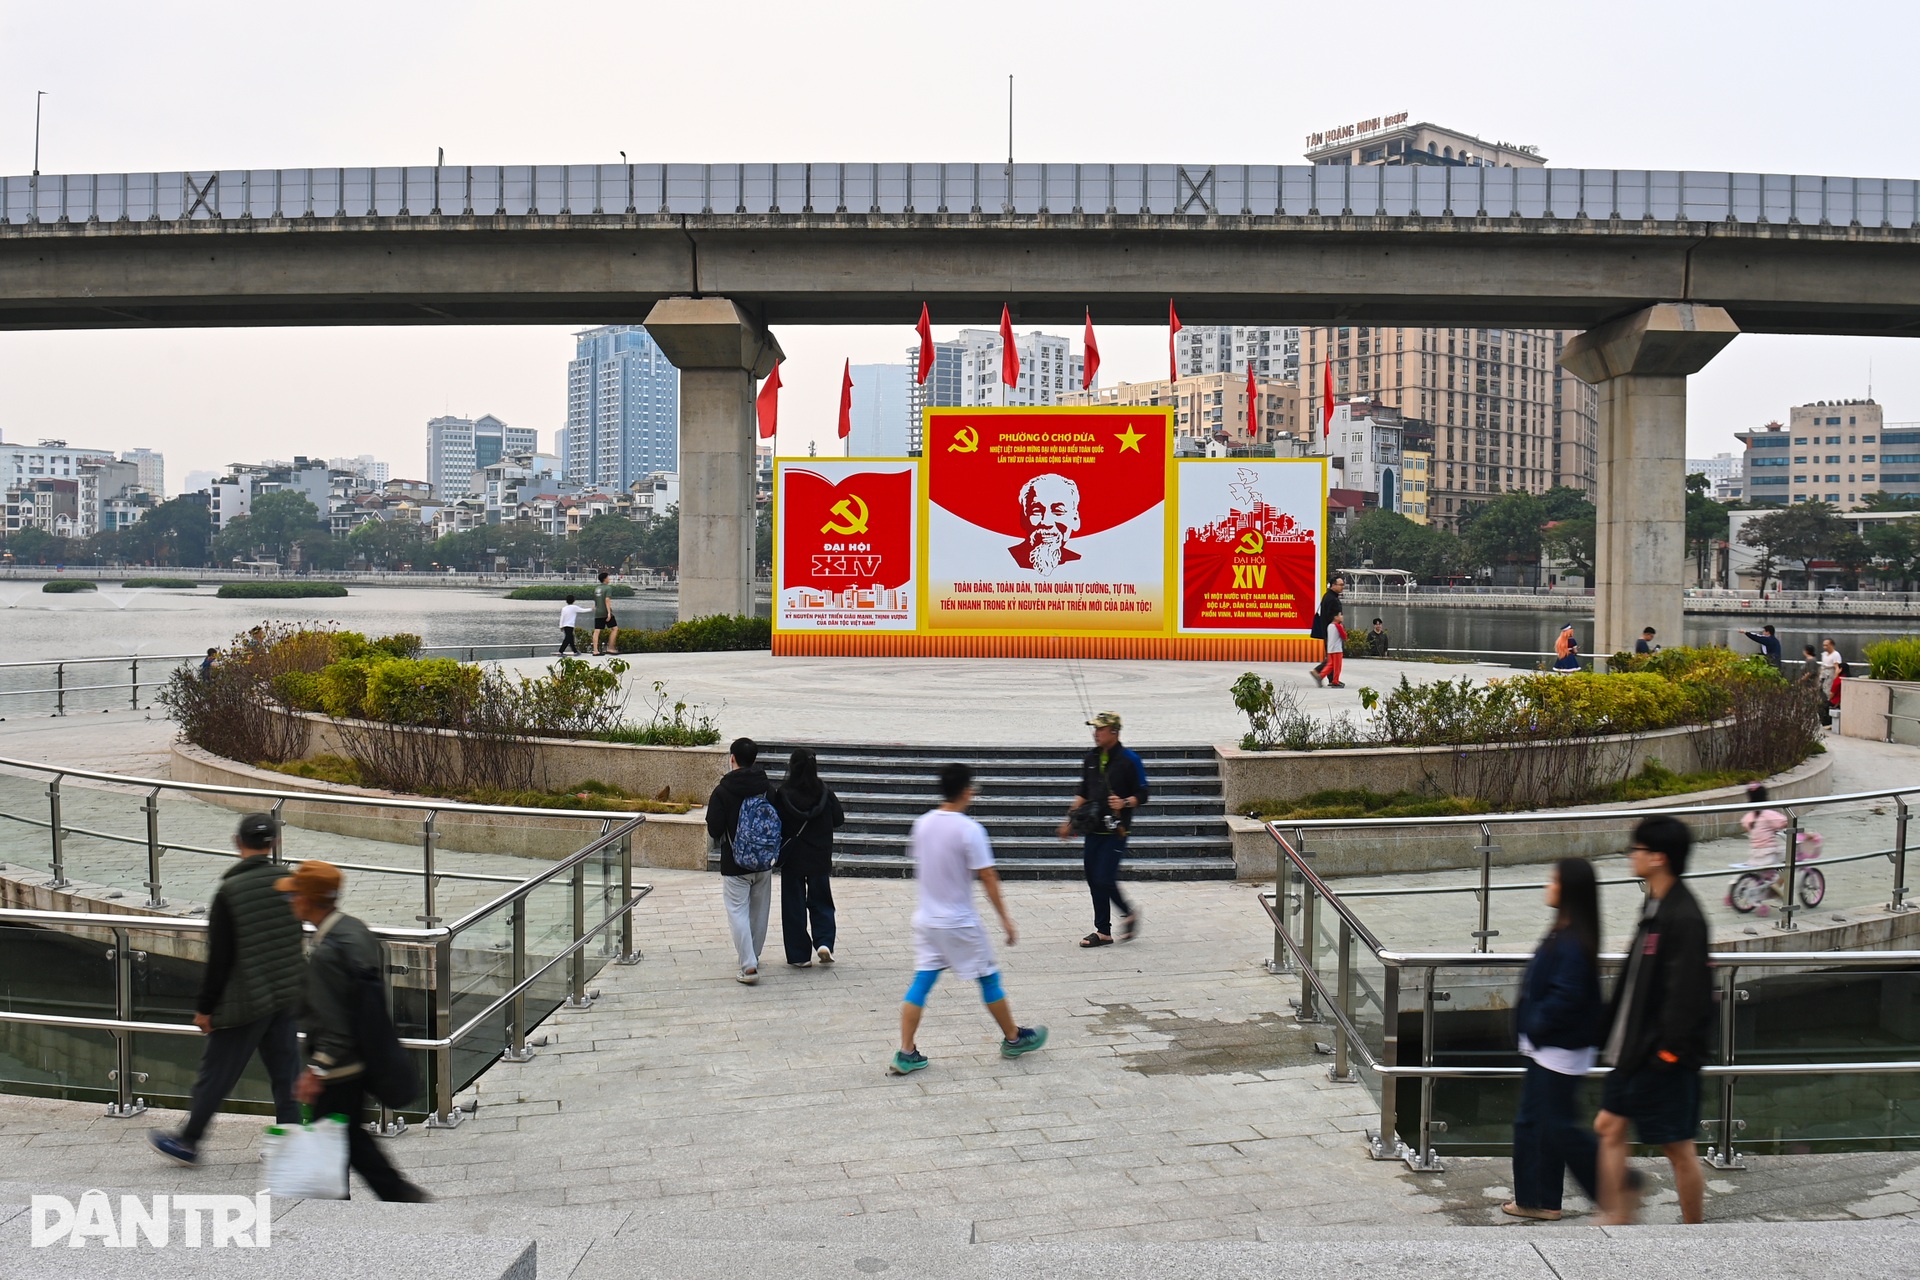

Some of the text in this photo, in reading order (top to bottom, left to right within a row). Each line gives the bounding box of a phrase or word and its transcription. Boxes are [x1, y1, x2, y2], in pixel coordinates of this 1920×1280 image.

[1306, 112, 1408, 148] TÂN HOÀNG MINH GROUP
[999, 432, 1095, 443] PHƯỜNG Ô CHỢ DỪA
[824, 542, 870, 553] ĐẠI HỘI
[812, 555, 881, 576] XIV
[1251, 556, 1265, 564] HỘI
[1232, 565, 1267, 588] XIV
[954, 579, 1136, 596] TOÀN ĐẢNG, TOÀN DÂN, TOÀN QUÂN TỰ CƯỜNG, TỰ TIN,
[941, 597, 1152, 614] TIẾN NHANH TRONG KỶ NGUYÊN PHÁT TRIỂN MỚI CỦA DÂN TỘC!
